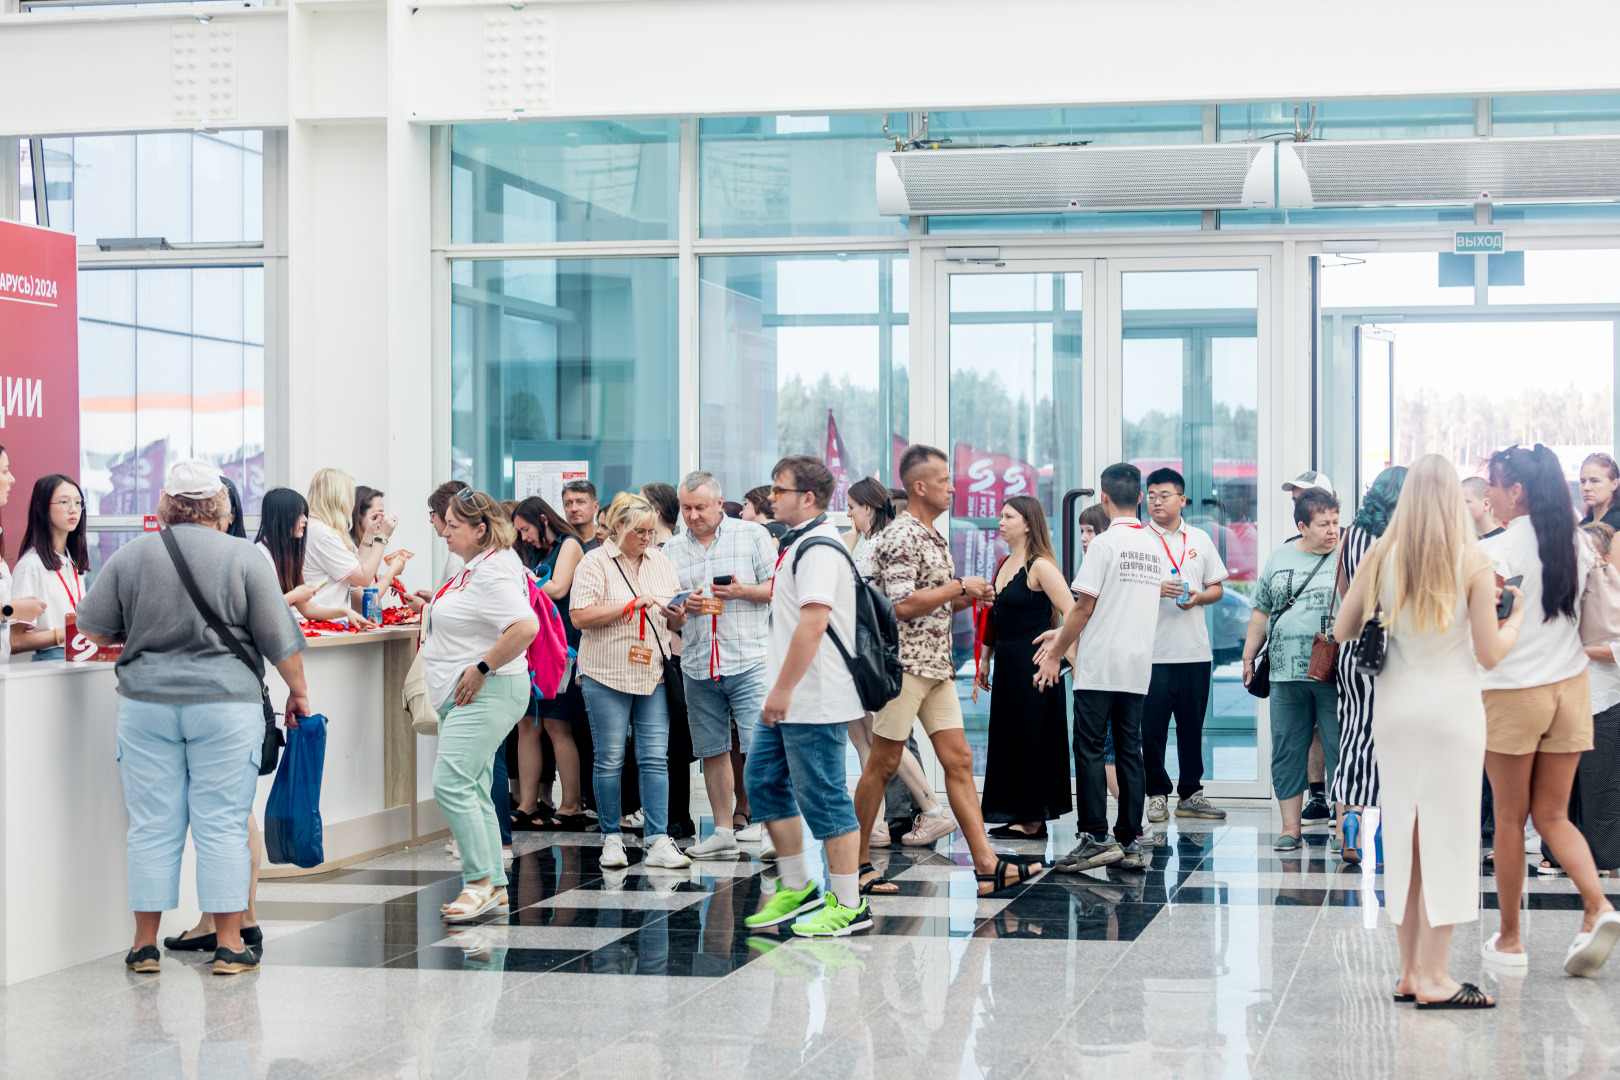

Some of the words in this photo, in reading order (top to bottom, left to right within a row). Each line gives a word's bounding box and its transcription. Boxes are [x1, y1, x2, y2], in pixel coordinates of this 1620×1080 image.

[1456, 235, 1502, 248] ВЫХОД
[0, 272, 34, 297] АРУСЬ)
[34, 278, 58, 299] 2024
